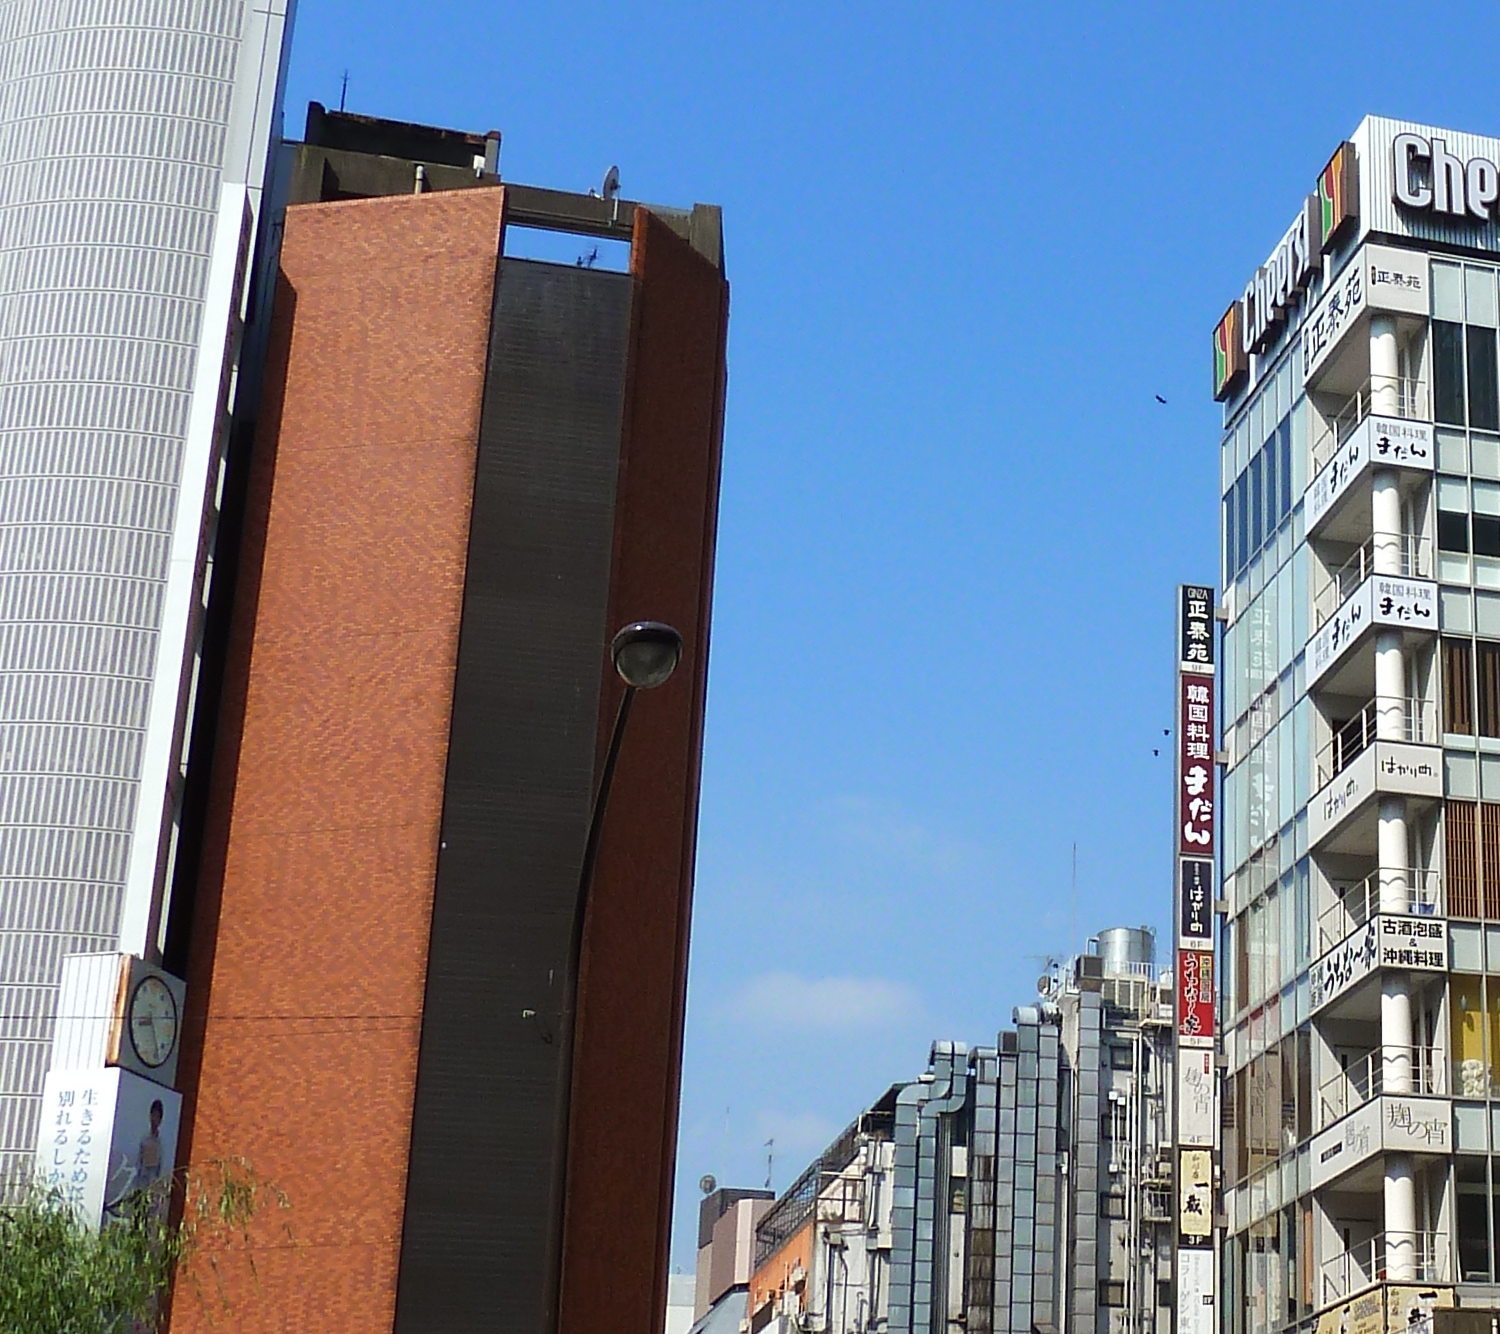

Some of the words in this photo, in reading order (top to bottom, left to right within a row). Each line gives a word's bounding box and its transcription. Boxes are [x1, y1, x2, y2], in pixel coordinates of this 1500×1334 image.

[1309, 267, 1362, 363] 正泰苑
[1376, 421, 1428, 442] 韓国料理
[1376, 437, 1427, 461] まだん
[1378, 582, 1431, 601] 韓国料理
[1378, 597, 1430, 621] まだん
[1187, 601, 1210, 662] 正泰苑
[1187, 685, 1210, 759] 韓国料理
[1184, 765, 1213, 846] まだん
[1382, 918, 1443, 938] 古酒泡盛
[1408, 938, 1418, 948] &
[48, 1090, 76, 1185] 別れるしか
[1188, 1235, 1203, 1245] 3F
